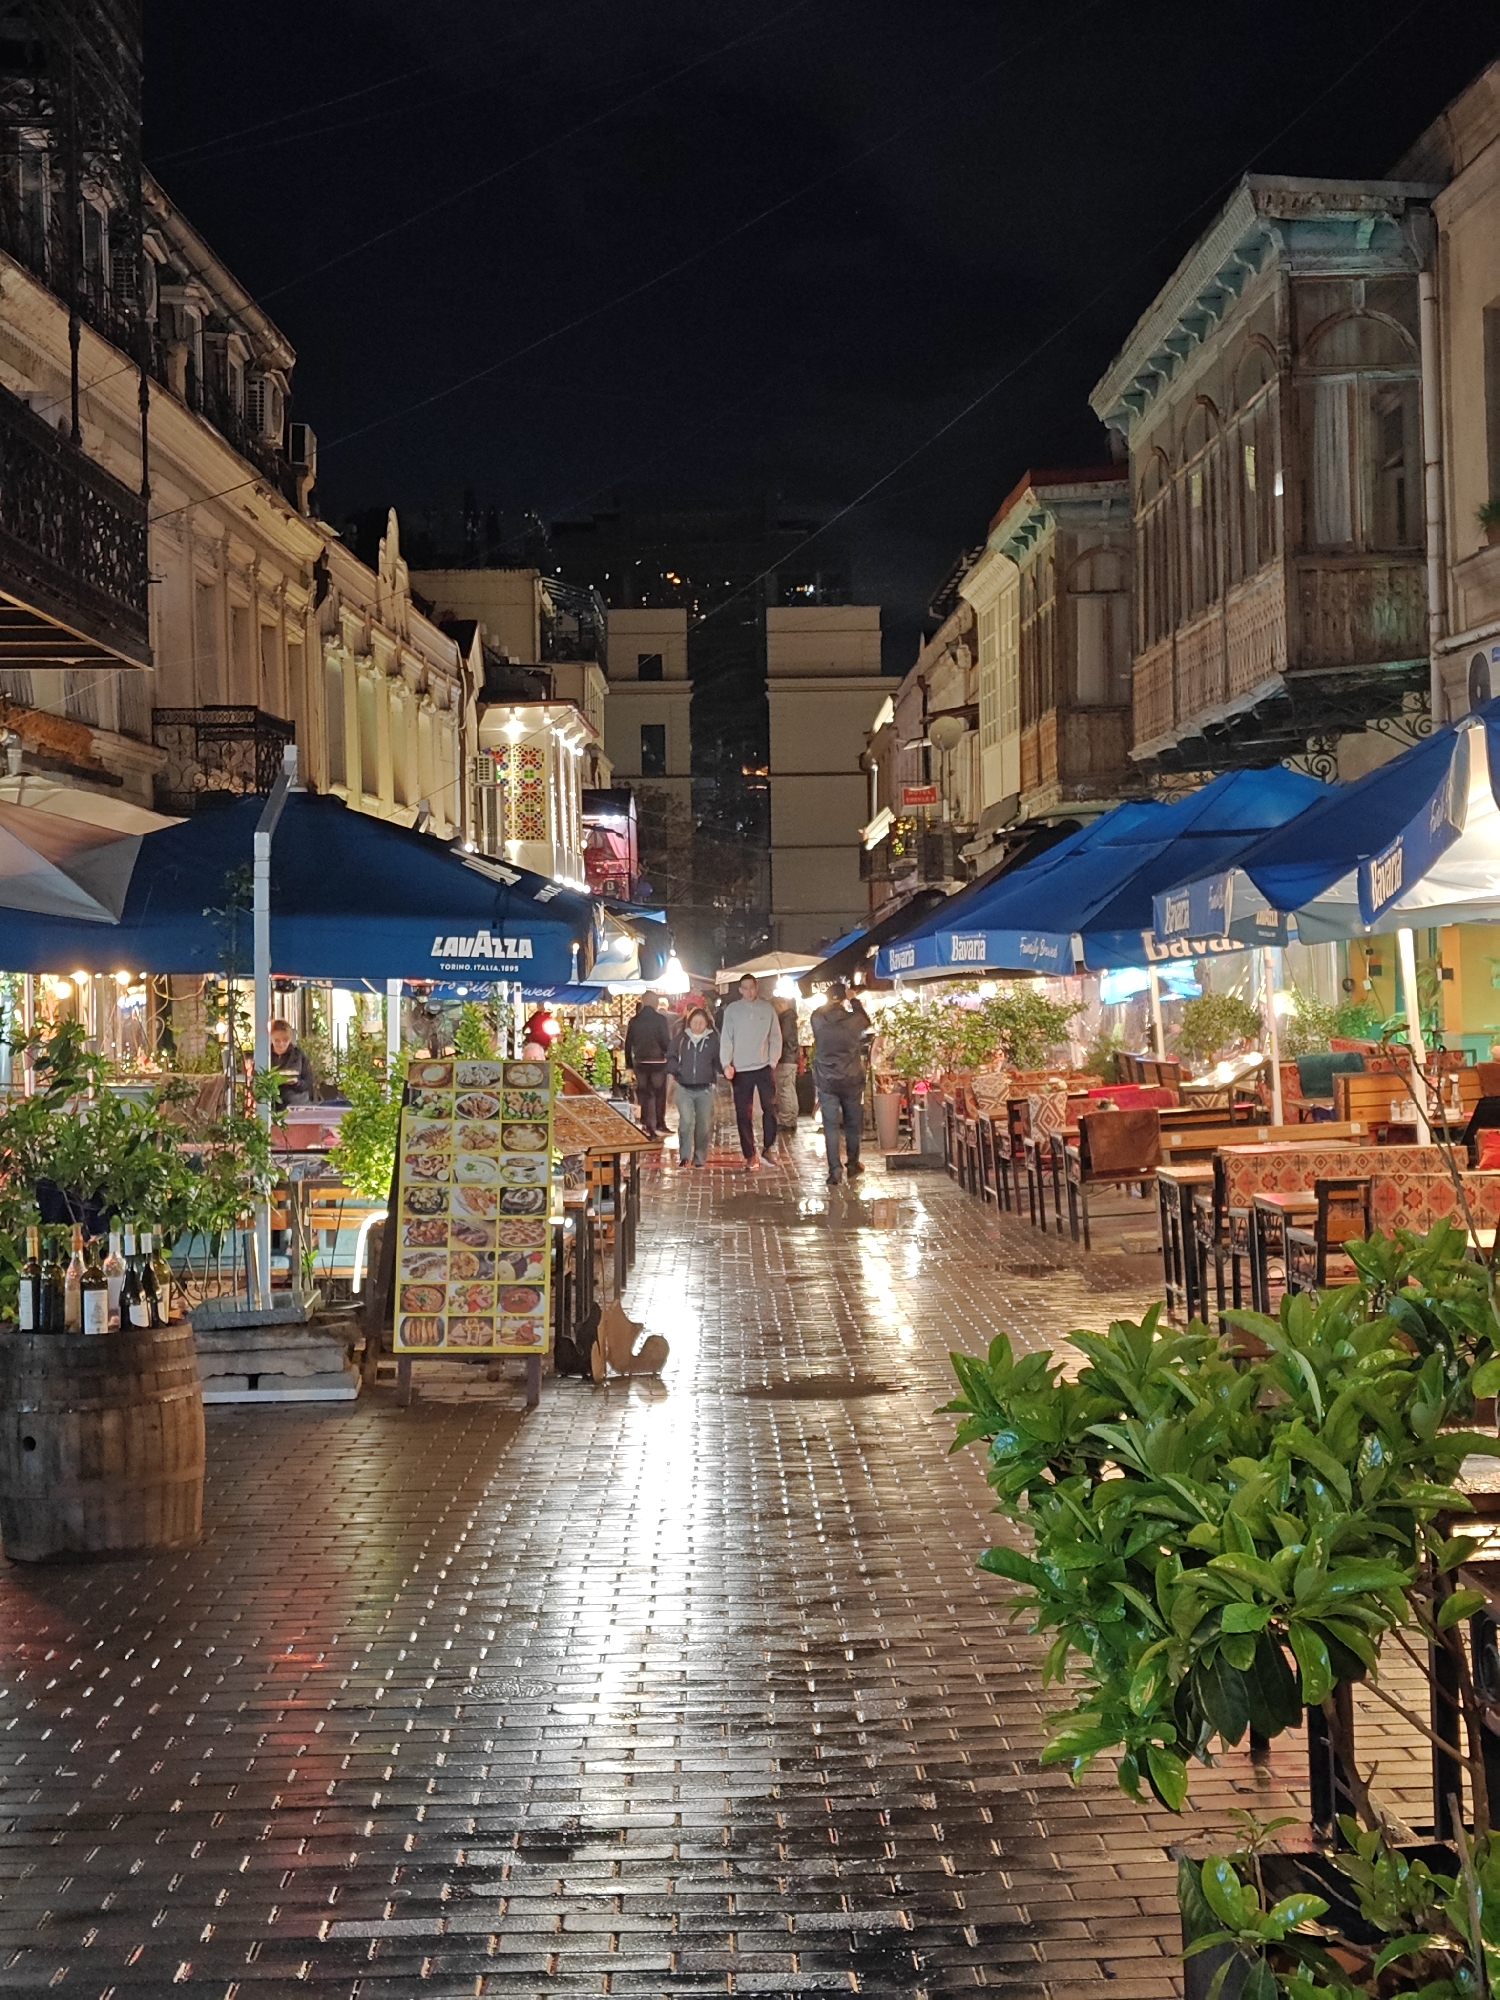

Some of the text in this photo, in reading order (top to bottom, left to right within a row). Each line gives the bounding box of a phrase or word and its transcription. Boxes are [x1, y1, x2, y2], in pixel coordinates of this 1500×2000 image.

[1369, 847, 1403, 913] Bavaria
[1165, 897, 1190, 935] Bavaria
[431, 930, 534, 959] LAVAZZA
[951, 935, 986, 962] Bavaria
[1019, 936, 1059, 963] Family Brewed
[501, 965, 519, 973] 1895
[889, 949, 915, 973] Bavaria
